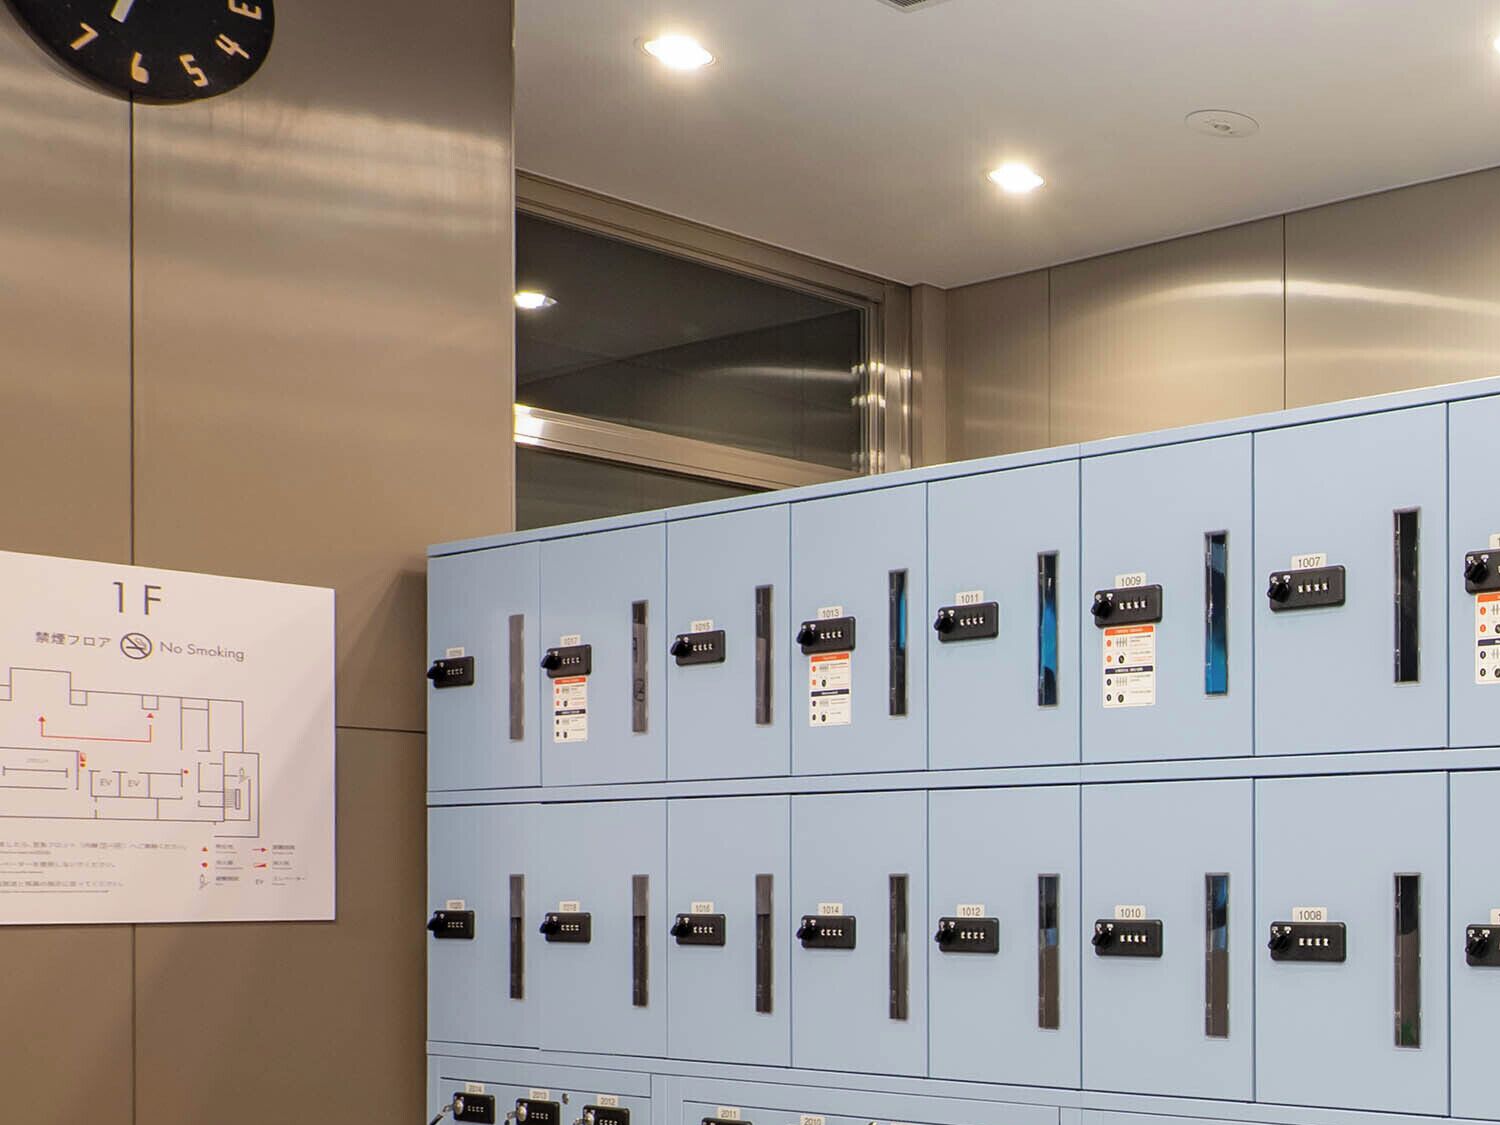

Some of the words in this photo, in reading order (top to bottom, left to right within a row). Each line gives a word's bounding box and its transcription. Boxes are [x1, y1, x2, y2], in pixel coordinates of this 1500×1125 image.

[69, 22, 99, 51] 7
[214, 32, 251, 60] 4
[130, 51, 151, 84] 6
[178, 53, 209, 88] 5
[1298, 556, 1321, 568] 1007
[1120, 576, 1142, 587] 1009
[960, 593, 979, 604] 1011
[34, 630, 112, 649] 禁煙フロア
[159, 641, 184, 655] No
[186, 643, 246, 663] Smoking
[962, 907, 981, 917] 1012
[1120, 908, 1142, 918] 1010
[1299, 910, 1322, 921] 1008
[720, 1110, 737, 1118] 2011
